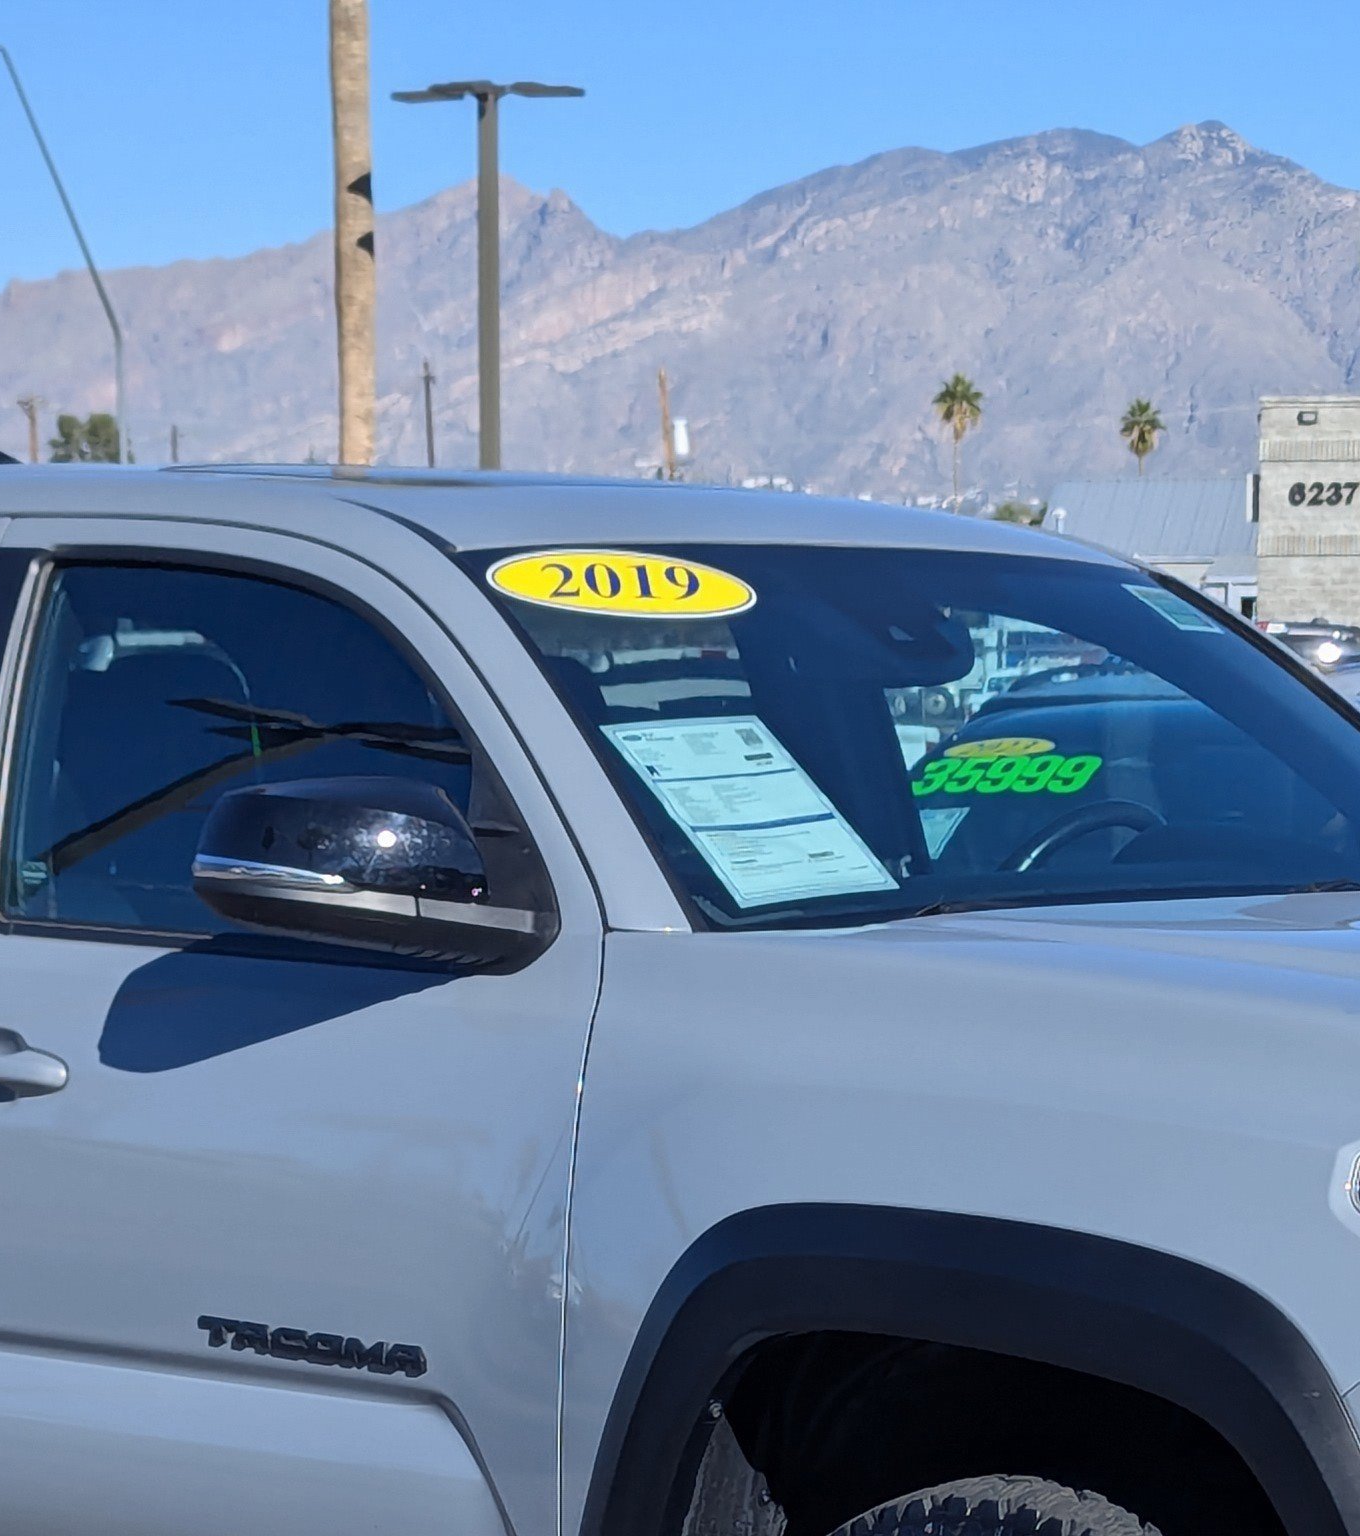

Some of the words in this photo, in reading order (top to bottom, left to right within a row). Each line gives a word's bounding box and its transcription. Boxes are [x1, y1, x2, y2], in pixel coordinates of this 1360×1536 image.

[1288, 482, 1360, 507] 6237
[540, 562, 700, 600] 2019
[911, 754, 1102, 797] 35999
[197, 1315, 428, 1378] TACOMA
